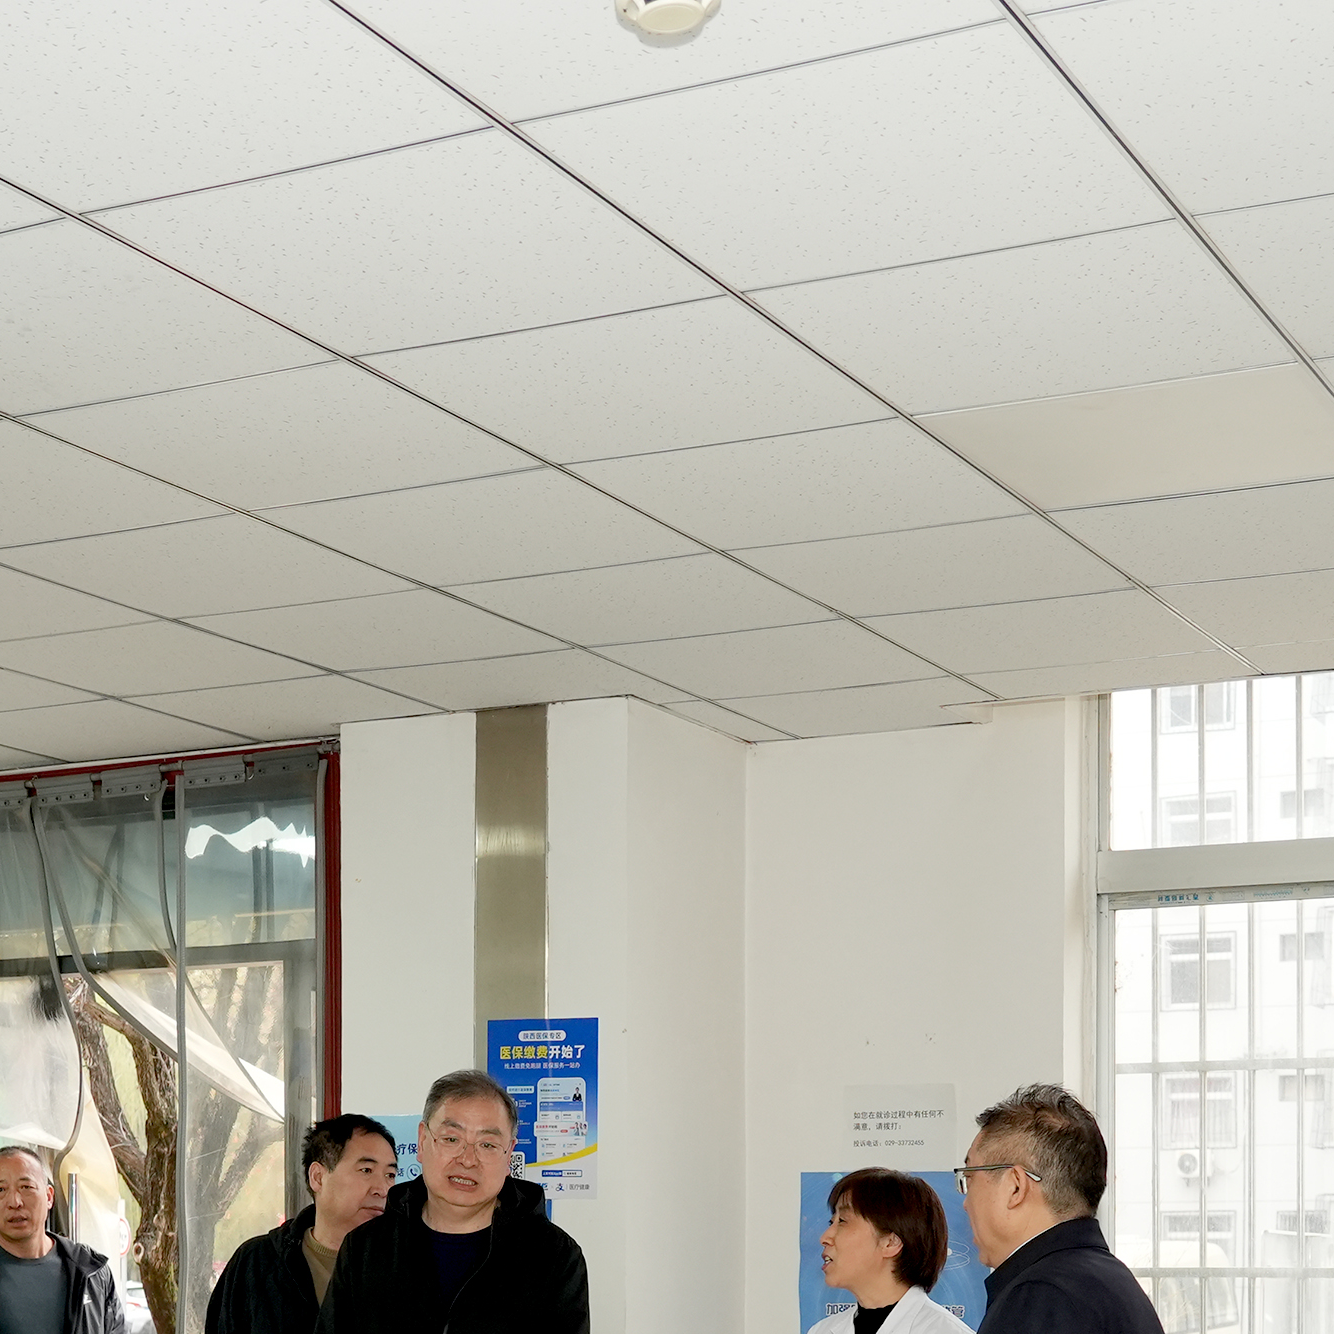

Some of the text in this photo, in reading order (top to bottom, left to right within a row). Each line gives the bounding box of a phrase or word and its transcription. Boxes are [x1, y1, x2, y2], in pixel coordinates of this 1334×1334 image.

[499, 1044, 586, 1060] 医保缴费开始了
